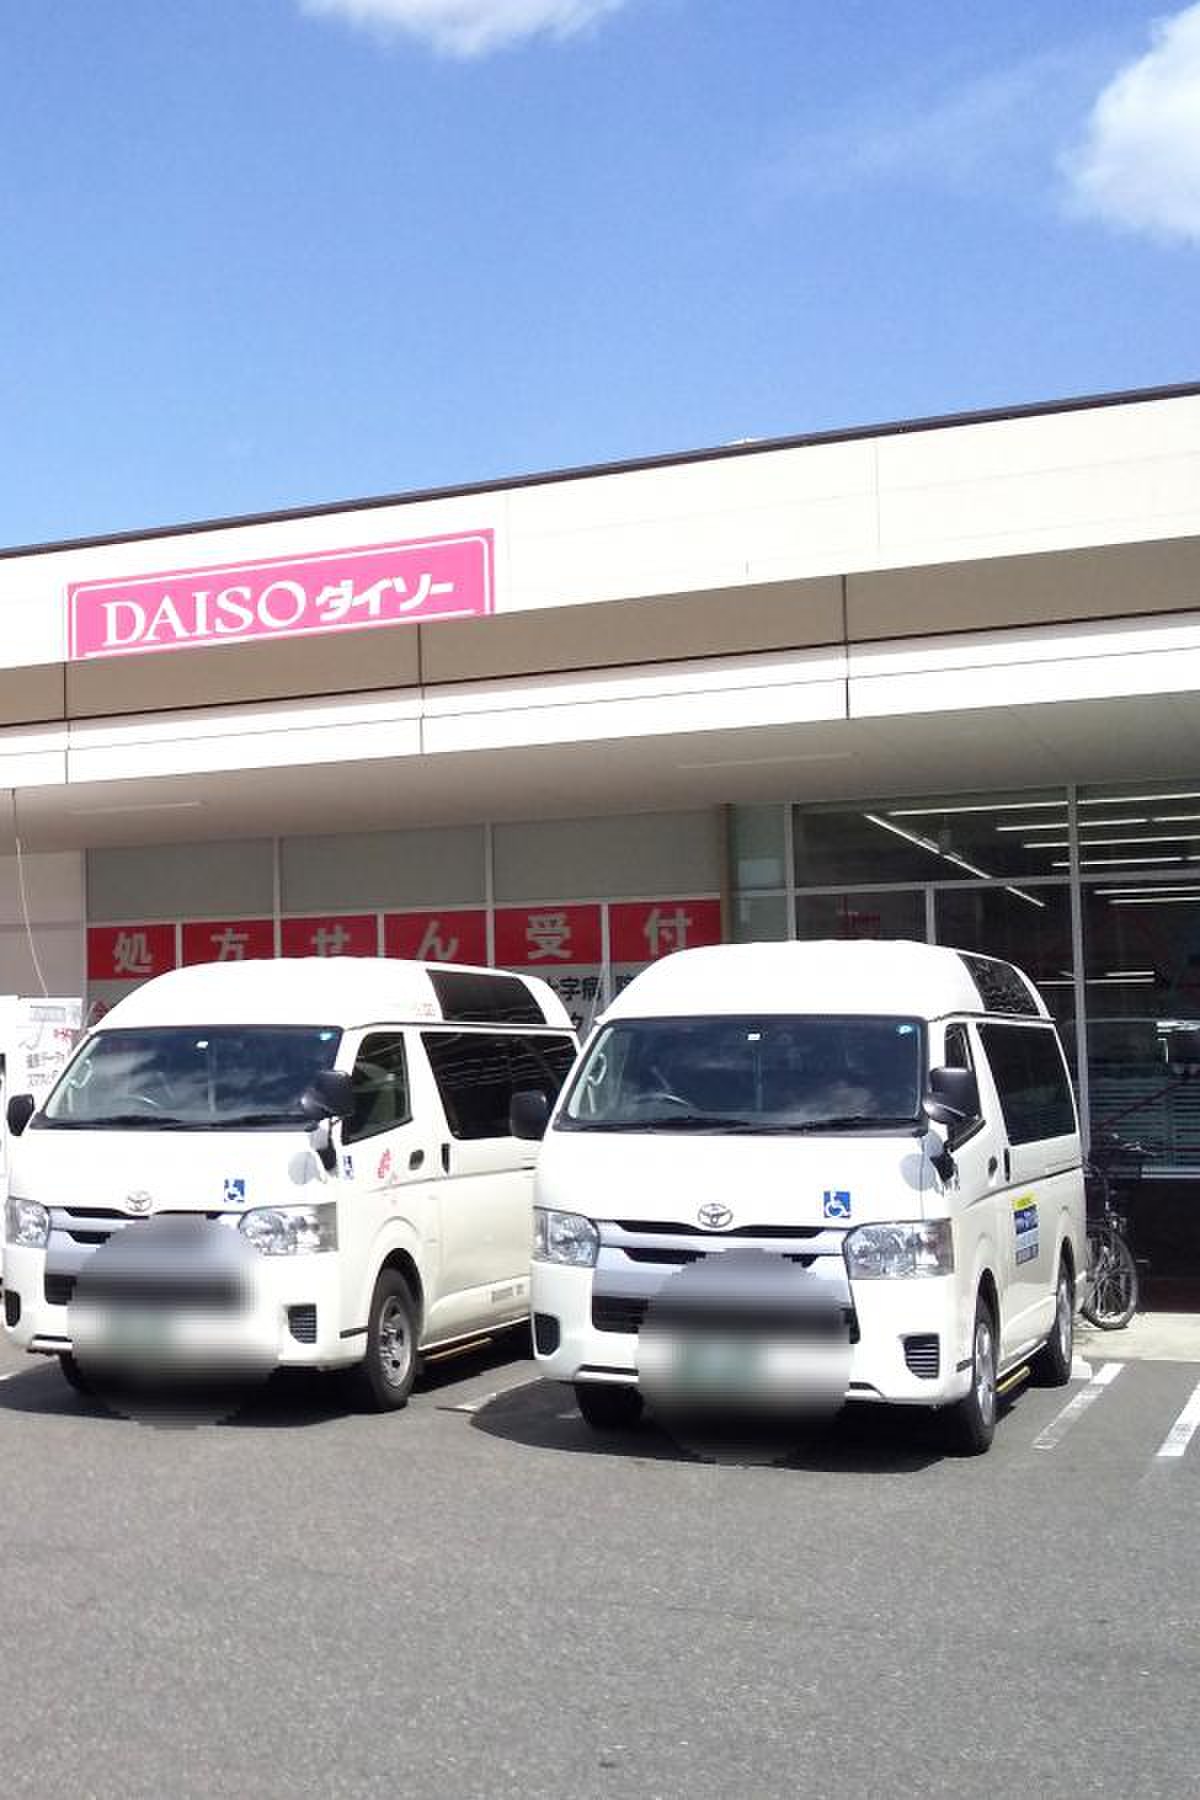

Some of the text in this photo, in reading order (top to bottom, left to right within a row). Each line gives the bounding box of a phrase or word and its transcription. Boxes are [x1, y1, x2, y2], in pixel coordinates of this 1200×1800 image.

[101, 574, 454, 648] DAISO ダイソー
